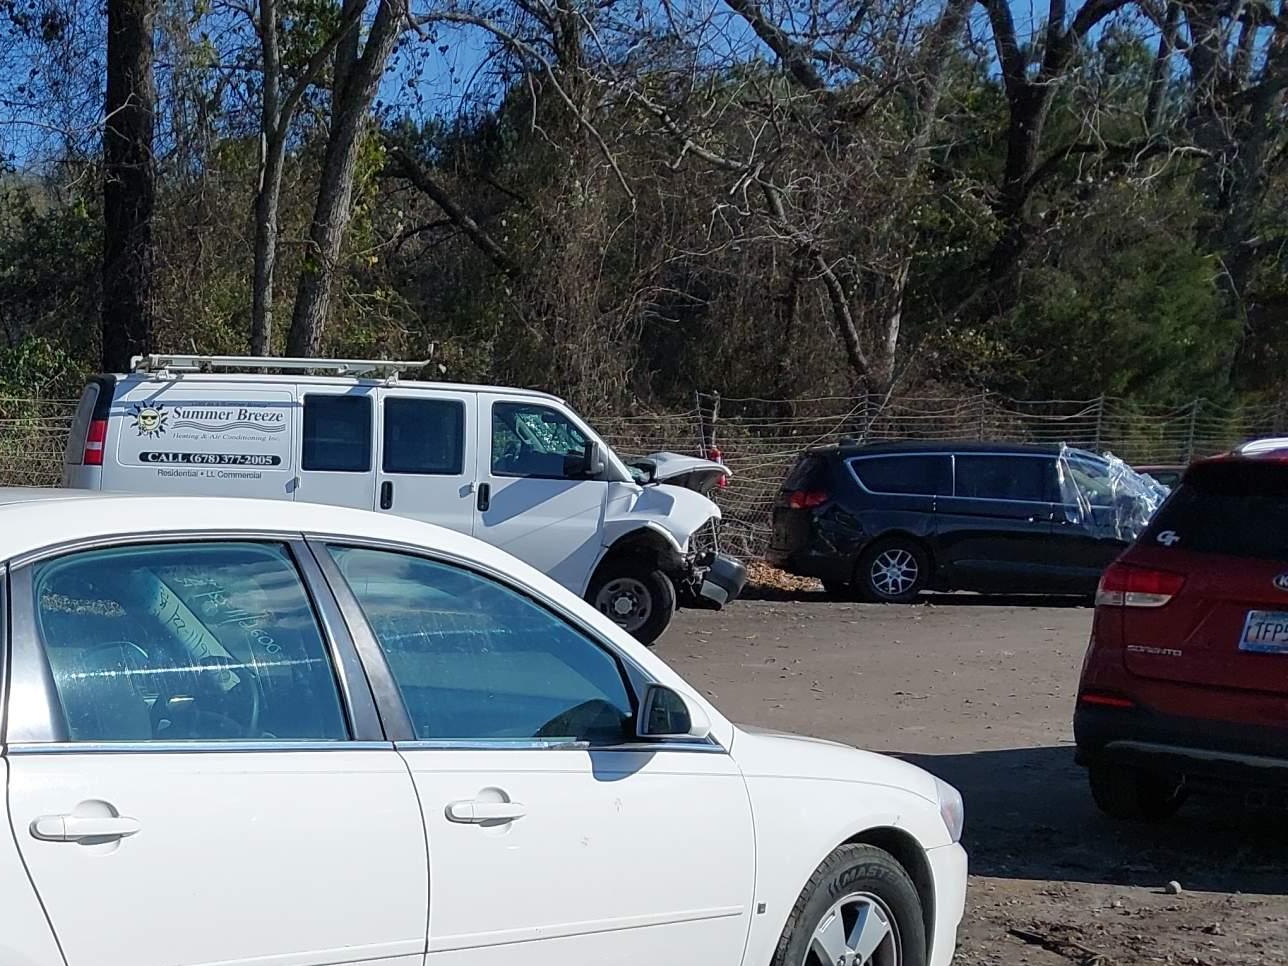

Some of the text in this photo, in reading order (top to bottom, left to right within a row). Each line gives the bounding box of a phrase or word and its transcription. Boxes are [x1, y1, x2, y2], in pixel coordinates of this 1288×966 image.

[172, 407, 284, 422] Summer Breeze
[147, 452, 186, 463] CALL
[189, 454, 220, 464] (678)
[157, 468, 198, 477] Residential
[217, 471, 262, 479] Commercial
